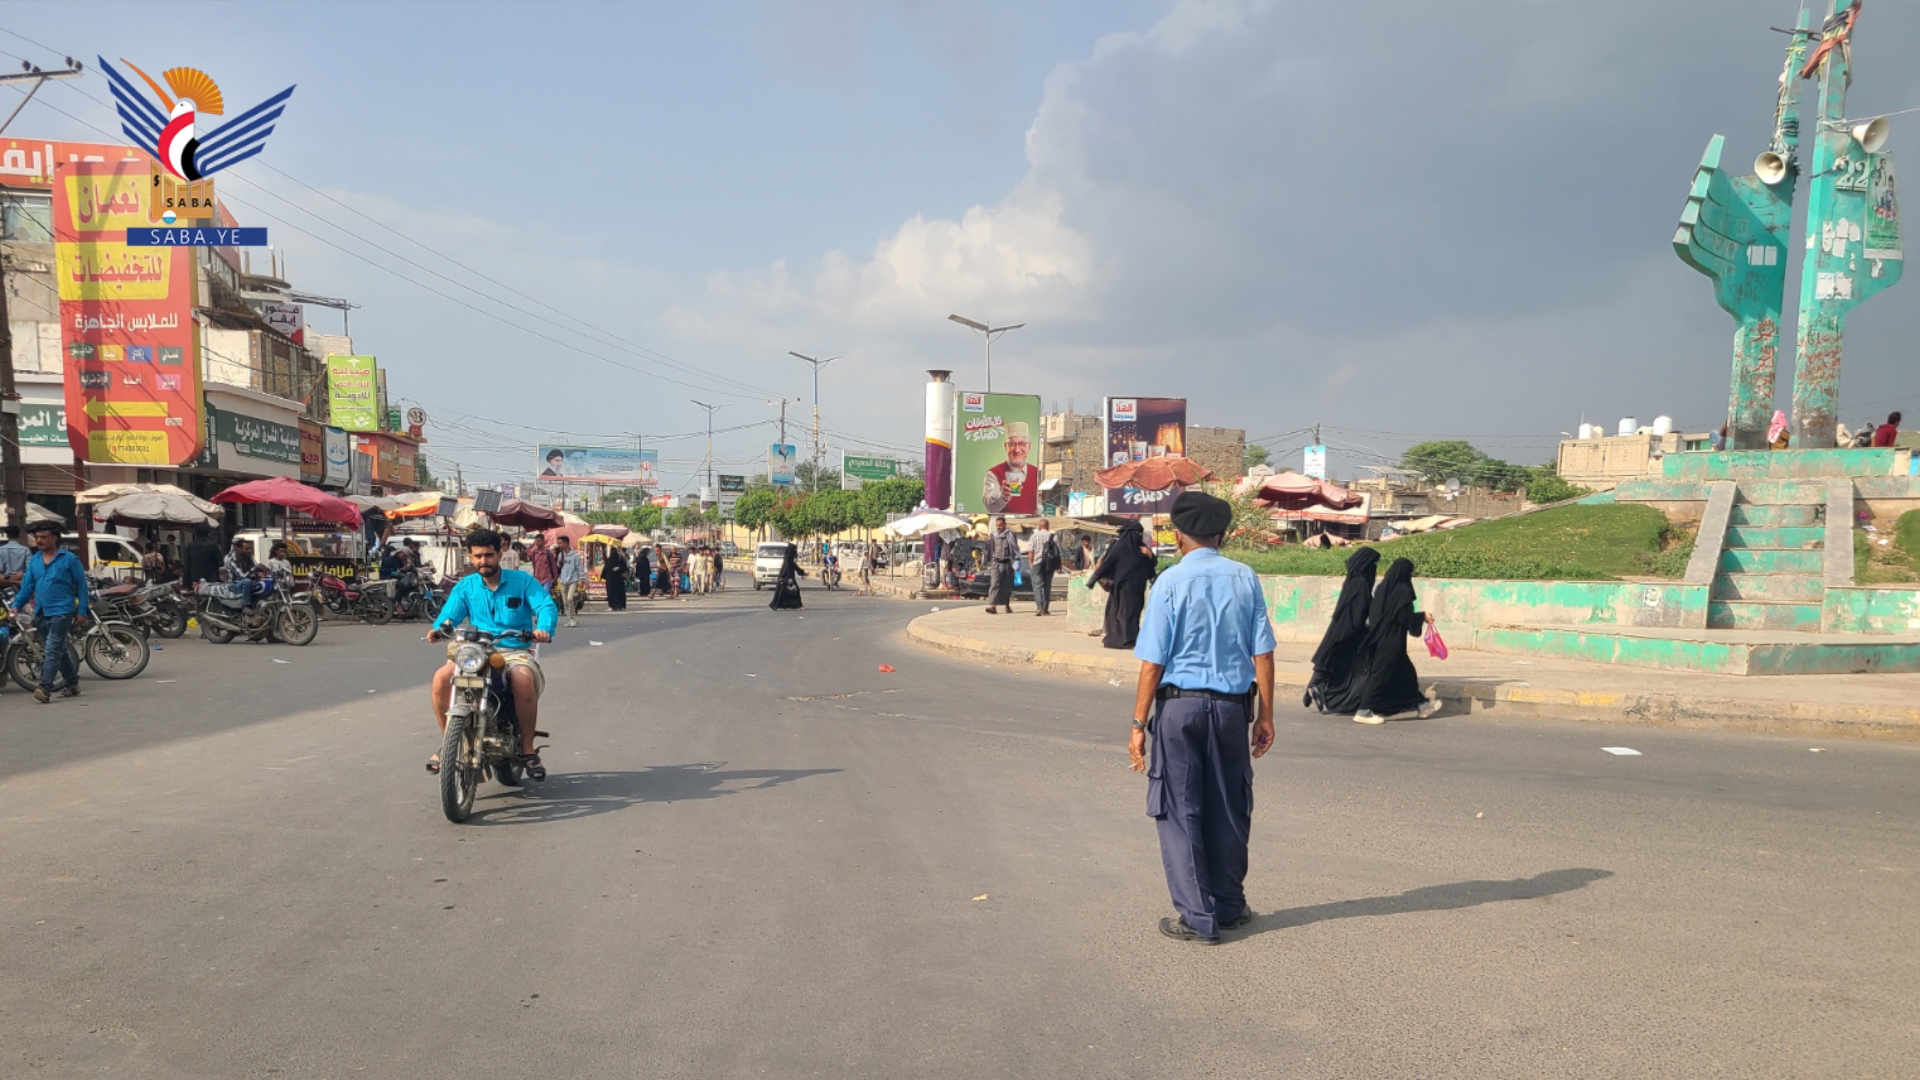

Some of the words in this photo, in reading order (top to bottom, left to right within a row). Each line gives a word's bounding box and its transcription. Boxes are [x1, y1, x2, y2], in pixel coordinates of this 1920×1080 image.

[80, 180, 140, 224] نعمان
[72, 252, 163, 290] للتخفيضات
[74, 313, 124, 334] الجاهزة
[127, 313, 179, 333] للملابس
[332, 365, 370, 378] صيدلية
